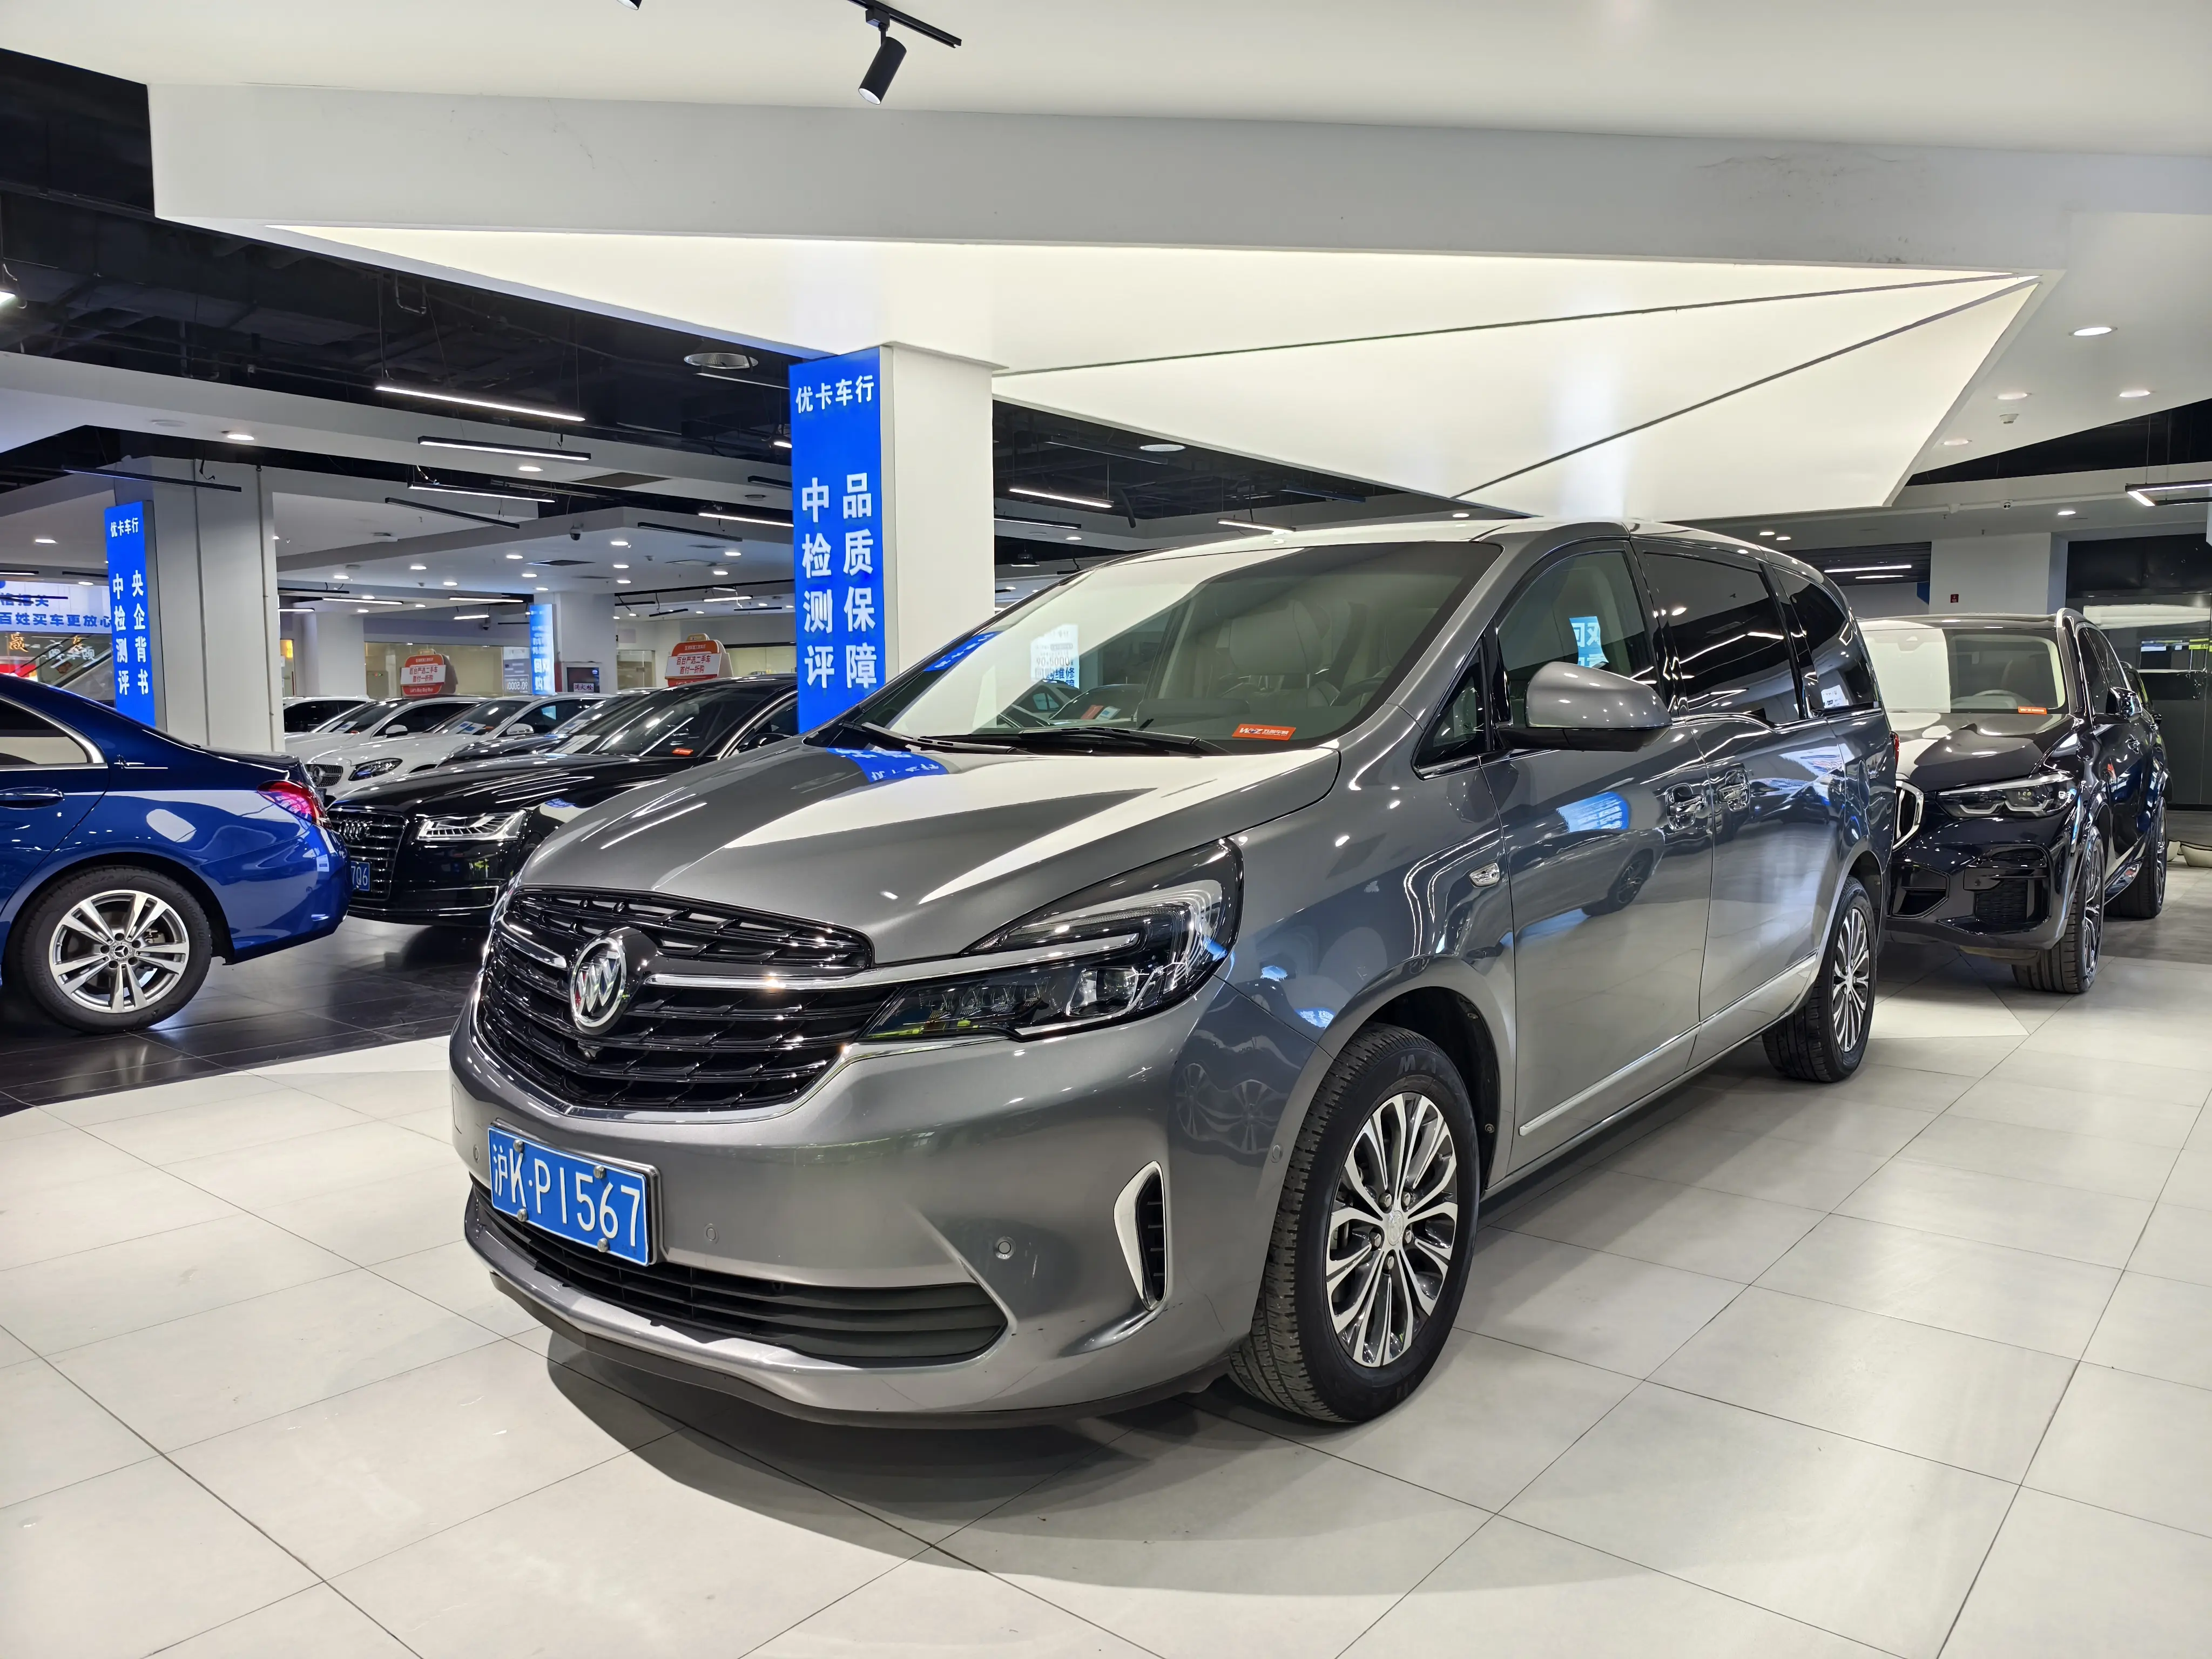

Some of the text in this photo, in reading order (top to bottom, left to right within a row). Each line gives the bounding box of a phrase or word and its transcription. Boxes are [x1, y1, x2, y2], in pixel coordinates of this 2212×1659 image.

[795, 375, 875, 414] 优卡车行
[110, 517, 139, 538] 优卡车行
[801, 477, 835, 689] 中检测评
[843, 472, 878, 689] 品质保障
[0, 612, 111, 628] 百姓买车更放心
[112, 573, 130, 695] 中检测评
[132, 569, 149, 694] 央企背书
[677, 655, 711, 665] 百台严选二手车
[350, 865, 368, 886] 7Q6
[492, 1143, 641, 1247] 沪K·P1567
